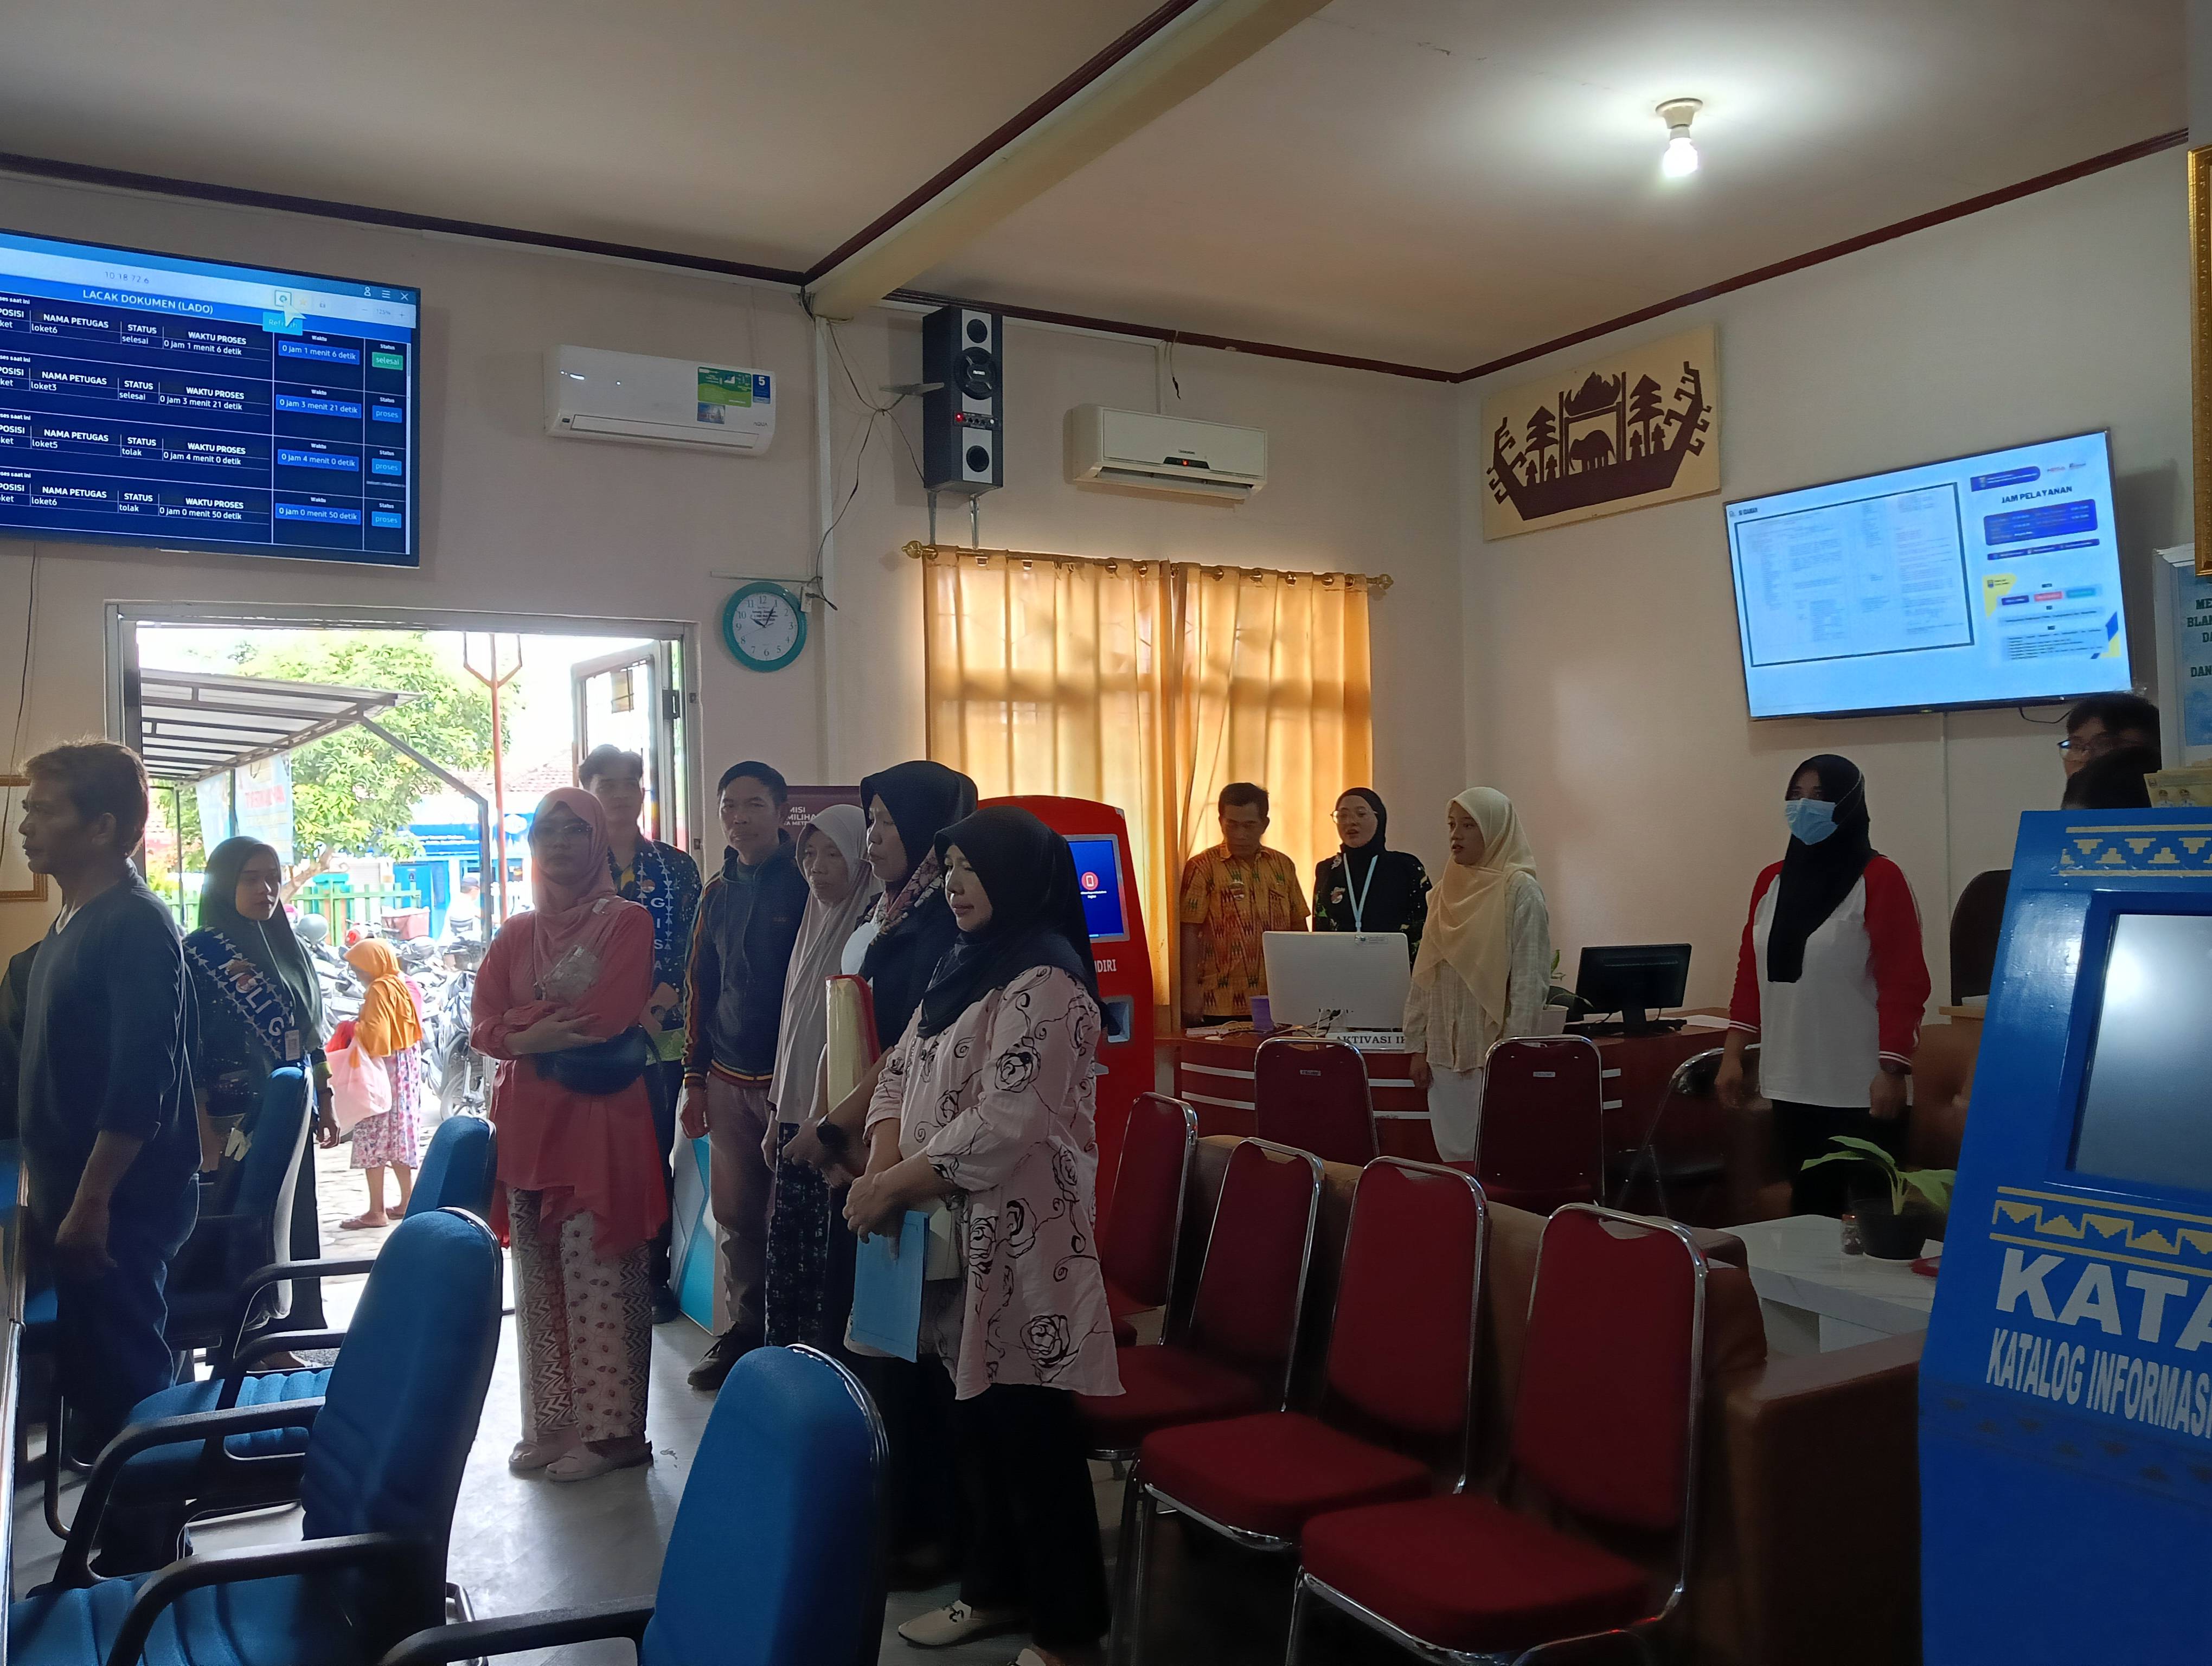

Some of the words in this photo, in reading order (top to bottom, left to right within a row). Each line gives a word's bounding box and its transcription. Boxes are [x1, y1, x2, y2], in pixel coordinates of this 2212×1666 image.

[83, 290, 118, 302] LACAK
[121, 294, 176, 309] DOKUMEN
[178, 302, 213, 315] (LADO)
[43, 313, 69, 324] NAMA
[71, 317, 108, 328] PETUGAS
[127, 324, 157, 334] STATUS
[188, 331, 215, 341] WAKTU
[217, 335, 246, 345] PROSES
[31, 324, 57, 334] loket6
[122, 335, 149, 344] selesai
[170, 341, 185, 349] jam
[194, 343, 215, 353] menit
[223, 347, 242, 355] detik
[289, 345, 302, 354] jam
[310, 348, 330, 357] menit
[338, 352, 356, 360] detik
[376, 357, 399, 366] selesai
[42, 371, 68, 381] NAMA
[69, 375, 107, 385] PETUGAS
[124, 380, 153, 390] STATUS
[186, 387, 214, 396] WAKTU
[215, 389, 245, 400] PROSES
[758, 376, 765, 386] 5
[31, 381, 57, 391] loket3
[119, 392, 145, 400] selesai
[166, 396, 181, 405] jam
[189, 398, 210, 407] menit
[223, 401, 242, 410] detik
[286, 400, 299, 408] jam
[307, 401, 328, 411] menit
[340, 405, 358, 413] detik
[376, 410, 399, 419] proses
[44, 429, 70, 438] NAMA
[72, 432, 108, 442] PETUGAS
[127, 437, 156, 446] STATUS
[188, 443, 215, 452] WAKTU
[216, 445, 246, 454] PROSES
[0, 436, 14, 444] ket
[32, 439, 58, 448] loket5
[122, 447, 142, 456] tolak
[170, 452, 184, 461] jam
[193, 454, 214, 463] menit
[222, 457, 241, 465] detik
[310, 456, 330, 464] menit
[376, 463, 398, 471] proses
[42, 486, 68, 495] NAMA
[69, 489, 107, 498] PETUGAS
[124, 492, 153, 502] STATUS
[185, 498, 213, 507] WAKTU
[214, 500, 243, 509] PROSES
[2002, 495, 2018, 503] JAM
[2019, 486, 2072, 499] PELAYANAN
[0, 494, 14, 502] ket
[31, 497, 57, 506] loket6
[119, 504, 139, 512] tolak
[166, 508, 180, 516] jam
[189, 509, 210, 517] menit
[223, 511, 242, 520] detik
[286, 508, 298, 516] jam
[307, 509, 327, 518] menit
[339, 512, 357, 520] detik
[376, 516, 397, 524] proses
[759, 595, 767, 604] 12
[774, 599, 778, 607] 1
[1094, 959, 1117, 972] DIRI
[1986, 1327, 2085, 1405] KATALOG
